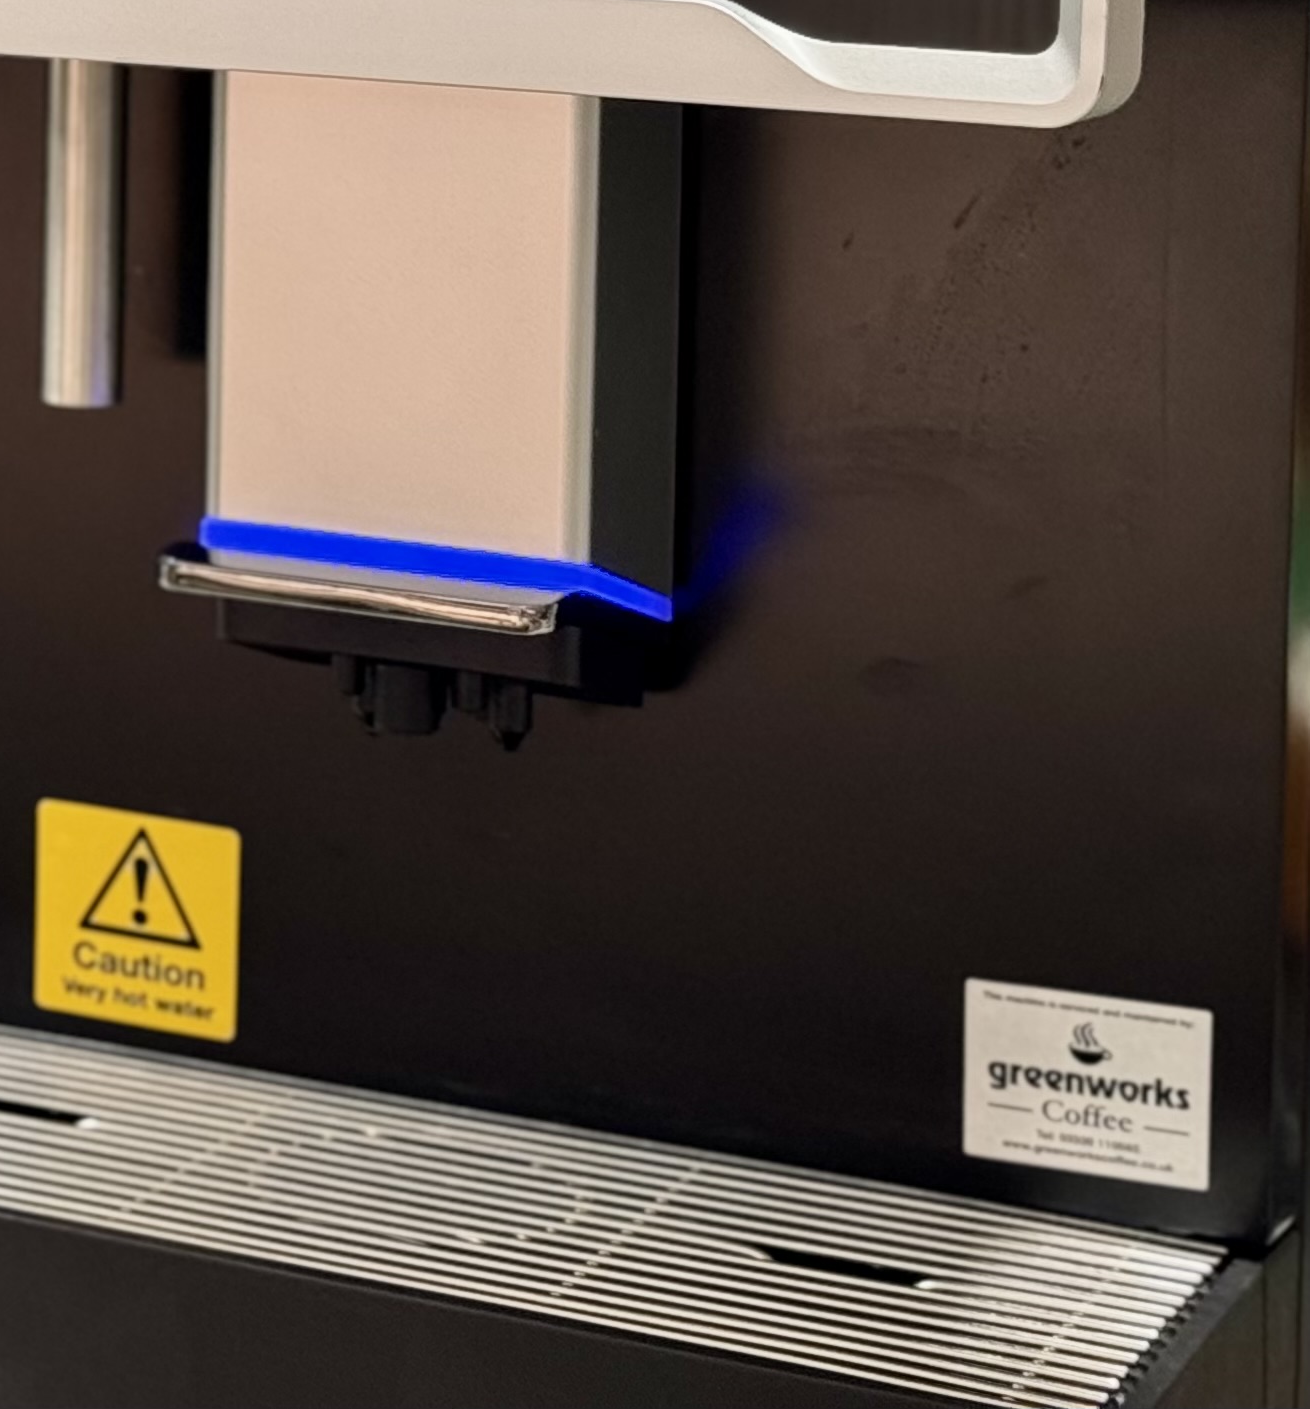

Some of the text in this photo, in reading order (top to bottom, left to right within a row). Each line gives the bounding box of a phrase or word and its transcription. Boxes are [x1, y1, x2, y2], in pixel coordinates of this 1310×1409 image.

[72, 940, 205, 990] Caution
[62, 977, 214, 1020] Very hot water
[988, 1060, 1191, 1111] greenworks
[1041, 1099, 1134, 1133] Coffee
